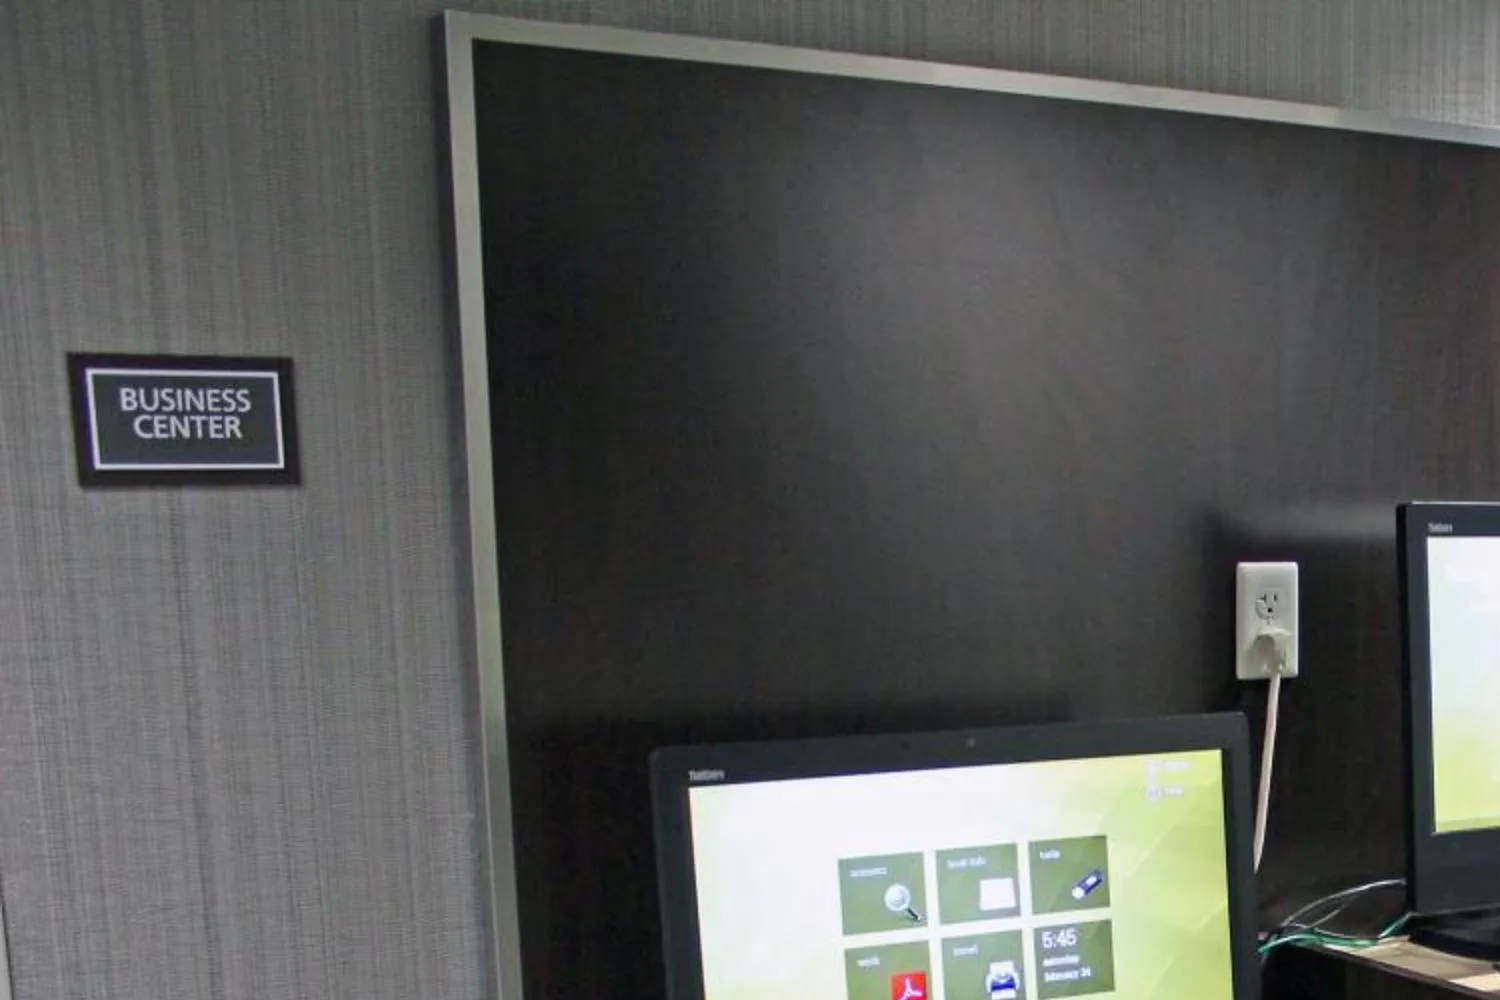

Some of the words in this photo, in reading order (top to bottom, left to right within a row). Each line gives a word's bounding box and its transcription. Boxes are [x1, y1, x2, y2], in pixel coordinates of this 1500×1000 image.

[119, 387, 251, 413] BUSINESS
[133, 415, 243, 440] CENTER
[1042, 928, 1077, 949] 5:45
